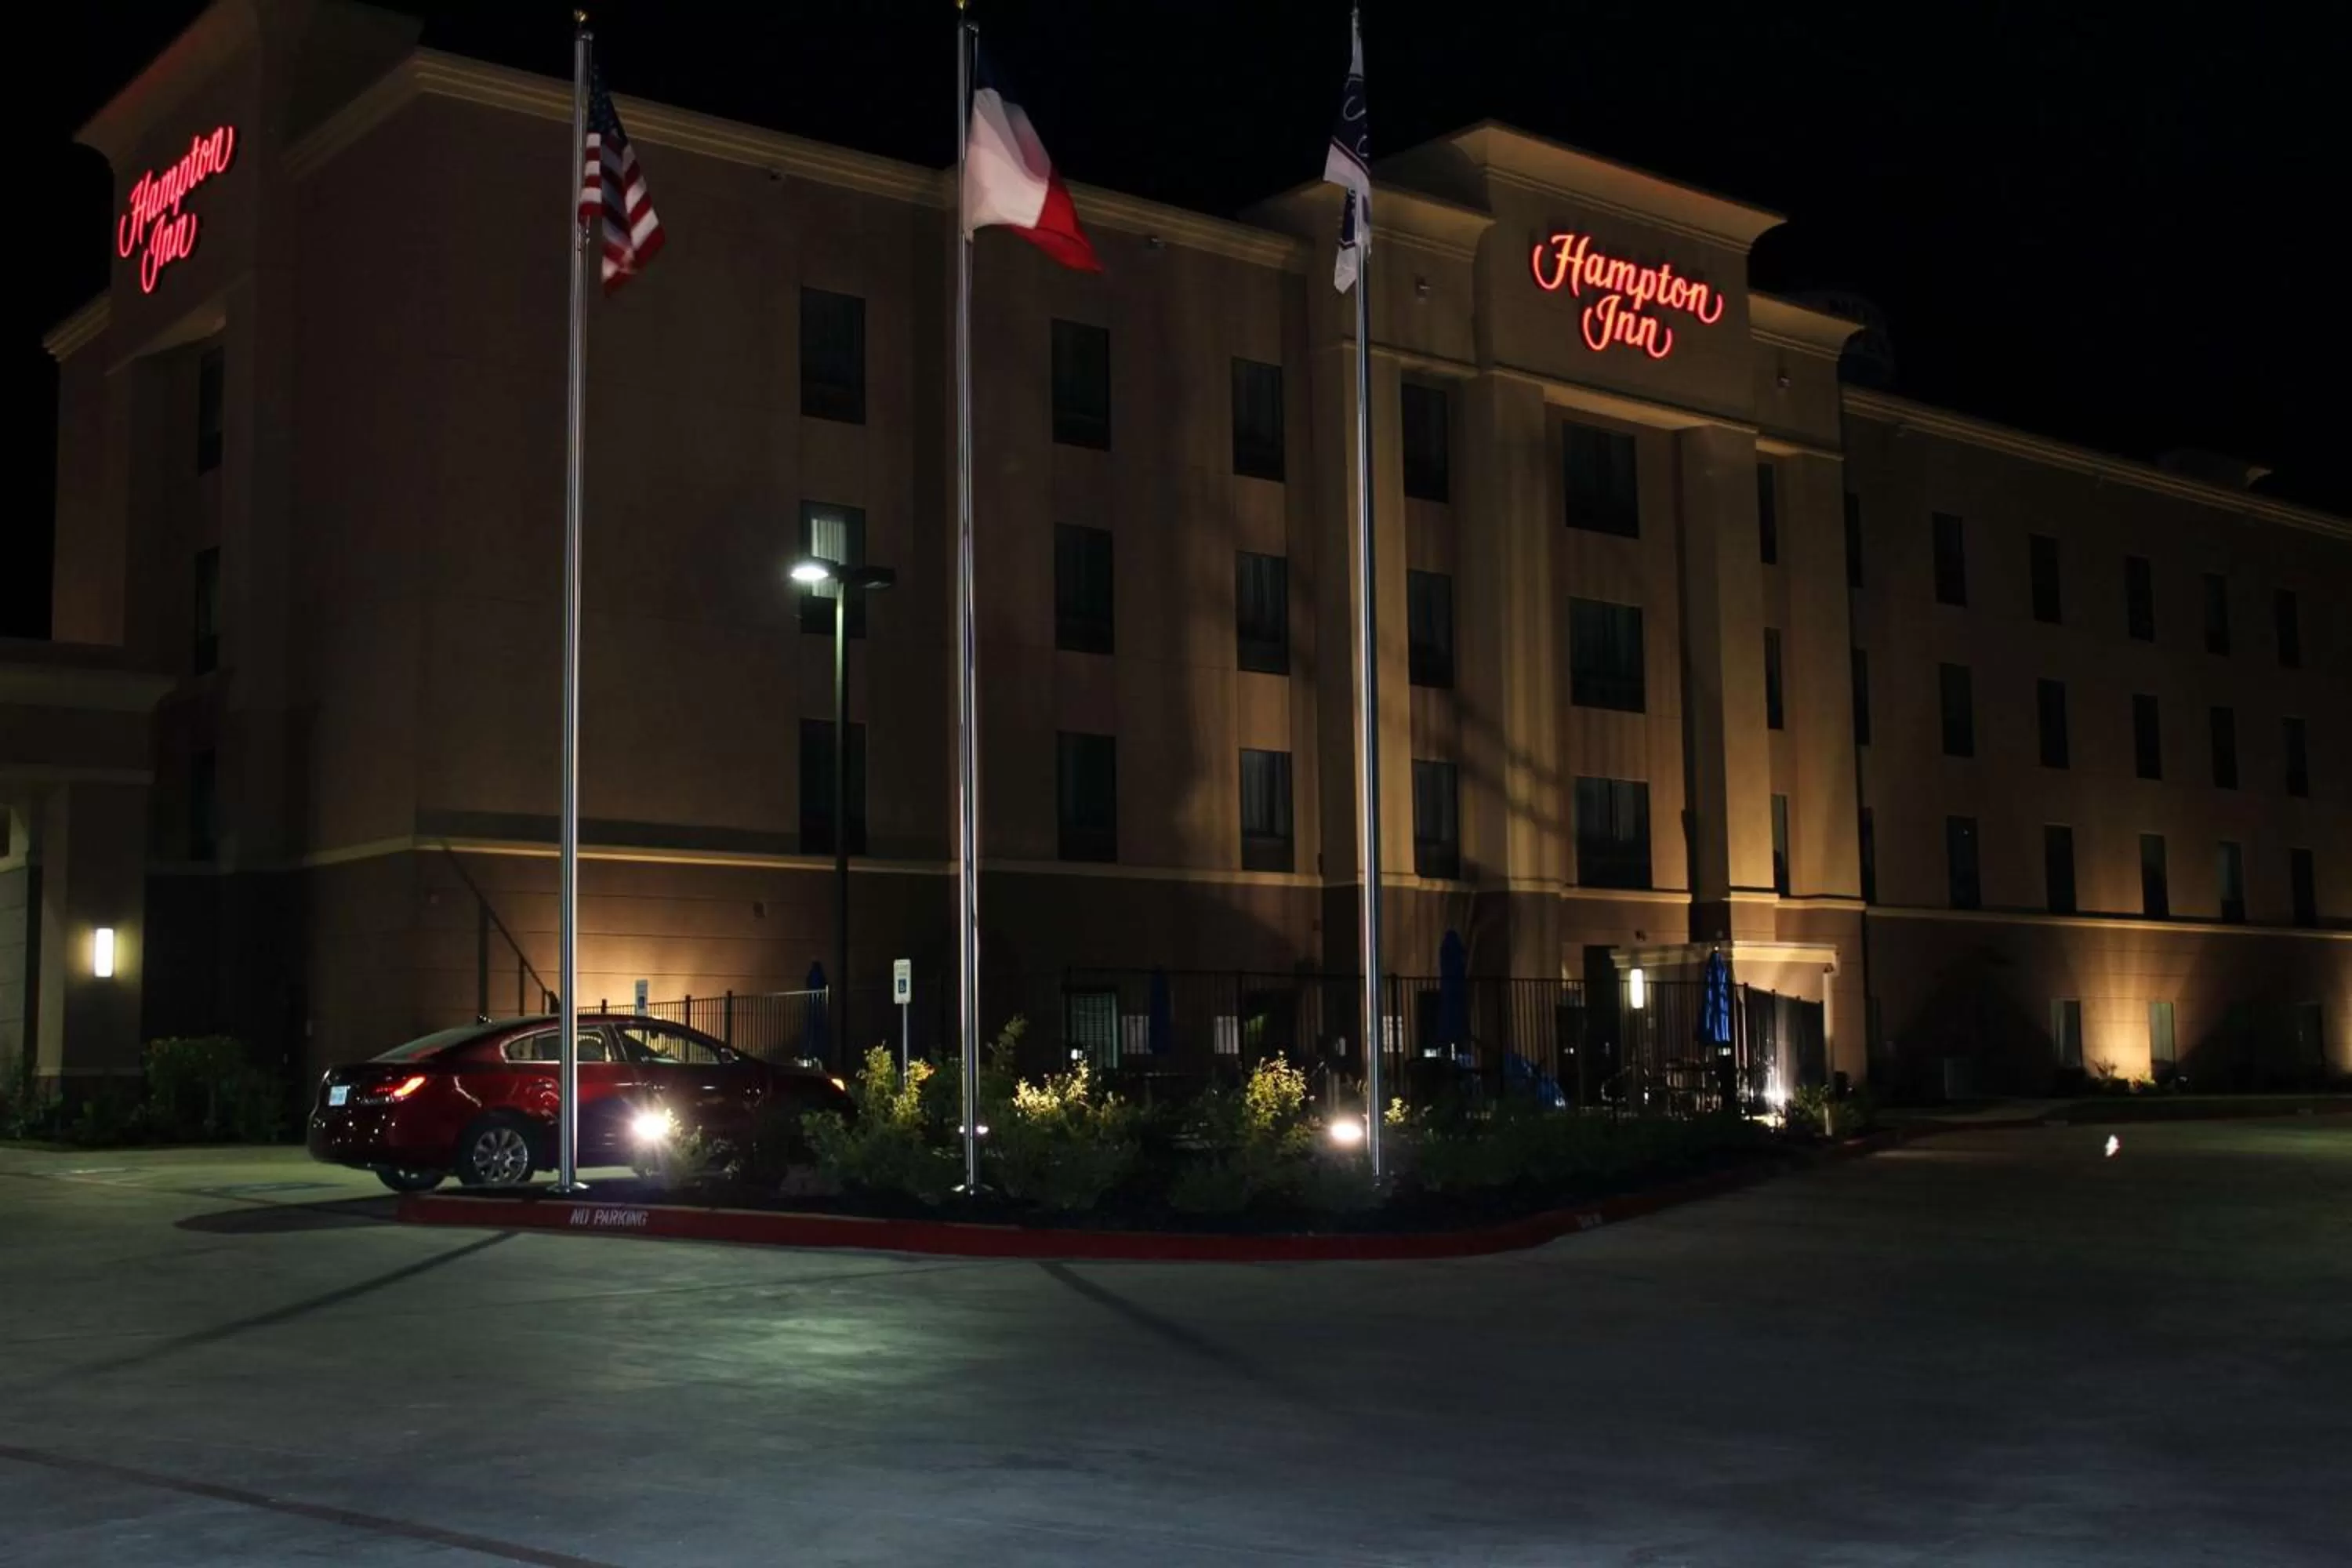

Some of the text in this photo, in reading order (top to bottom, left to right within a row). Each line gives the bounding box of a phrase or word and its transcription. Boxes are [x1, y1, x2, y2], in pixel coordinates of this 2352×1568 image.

[119, 125, 234, 257] Hampton
[141, 212, 197, 294] Inn
[1533, 234, 1723, 324] Hampton
[1583, 294, 1673, 358] Inn
[593, 1209, 649, 1227] PARKING
